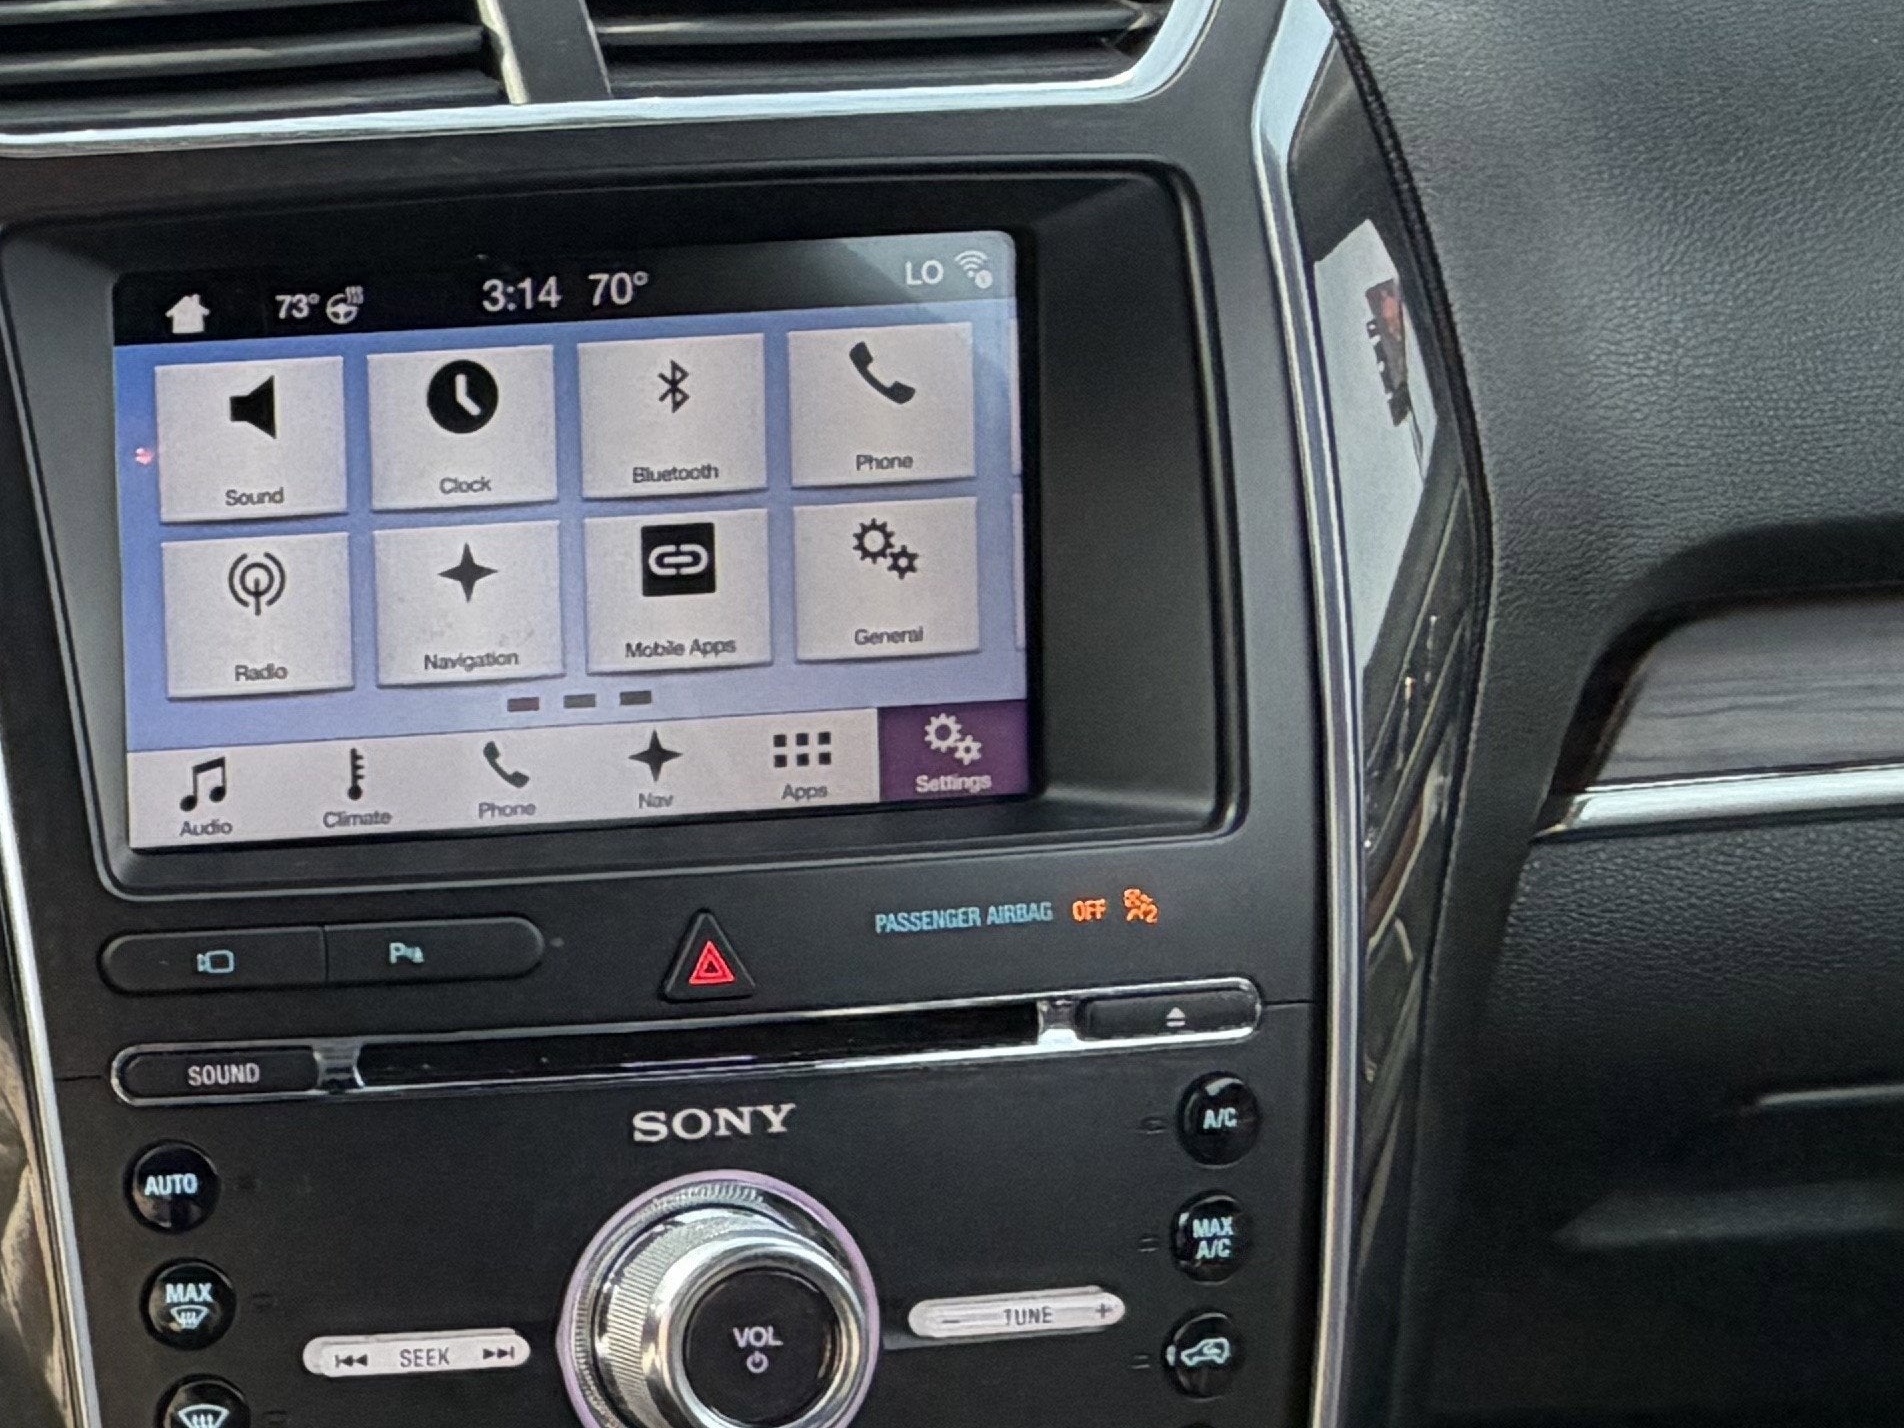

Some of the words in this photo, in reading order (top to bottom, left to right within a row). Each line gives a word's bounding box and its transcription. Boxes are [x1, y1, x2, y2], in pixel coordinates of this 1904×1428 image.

[905, 260, 944, 286] LO
[482, 276, 562, 312] 3:14
[589, 271, 649, 306] 70°
[276, 293, 319, 319] 73°
[856, 453, 913, 471] Phone
[632, 463, 719, 483] Bluetooth
[440, 477, 492, 495] Clock
[226, 487, 284, 506] Sound
[854, 626, 923, 646] General
[625, 639, 685, 659] Mobile
[689, 637, 736, 658] Apps
[424, 650, 519, 672] Navigation
[235, 663, 288, 682] Radio
[781, 783, 828, 801] Apps
[915, 774, 992, 794] Settings
[478, 800, 536, 820] Phone
[638, 792, 673, 809] Nav
[180, 818, 233, 837] Audio
[323, 809, 392, 828] Climate
[875, 906, 981, 934] PASSENGER
[986, 901, 1053, 927] AIRBAG
[1071, 898, 1106, 922] OFF
[188, 1062, 260, 1087] SOUND
[632, 1103, 796, 1142] SONY
[1203, 1107, 1238, 1129] A/C
[144, 1173, 198, 1197] AUTO
[1193, 1216, 1234, 1236] MAX
[1195, 1239, 1231, 1259] A/C
[165, 1283, 213, 1303] MAX
[1004, 1306, 1053, 1325] TUNE
[732, 1325, 783, 1348] VOL
[399, 1348, 450, 1368] SEEK
